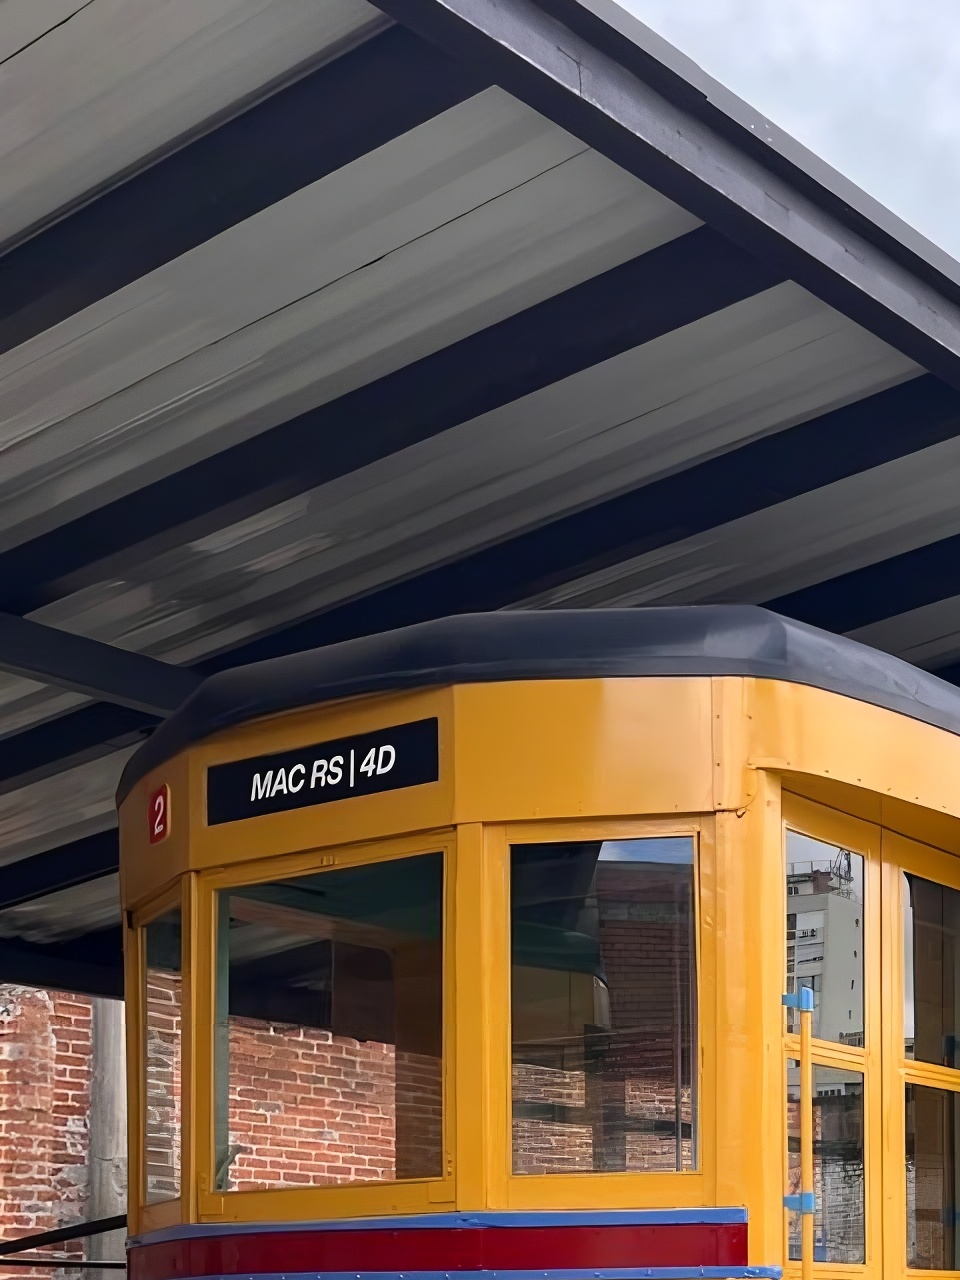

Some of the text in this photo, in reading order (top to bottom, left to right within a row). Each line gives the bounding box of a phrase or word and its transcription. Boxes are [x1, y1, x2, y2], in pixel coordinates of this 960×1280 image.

[250, 763, 306, 802] MAC
[360, 744, 396, 778] 4D
[153, 795, 165, 836] 2
